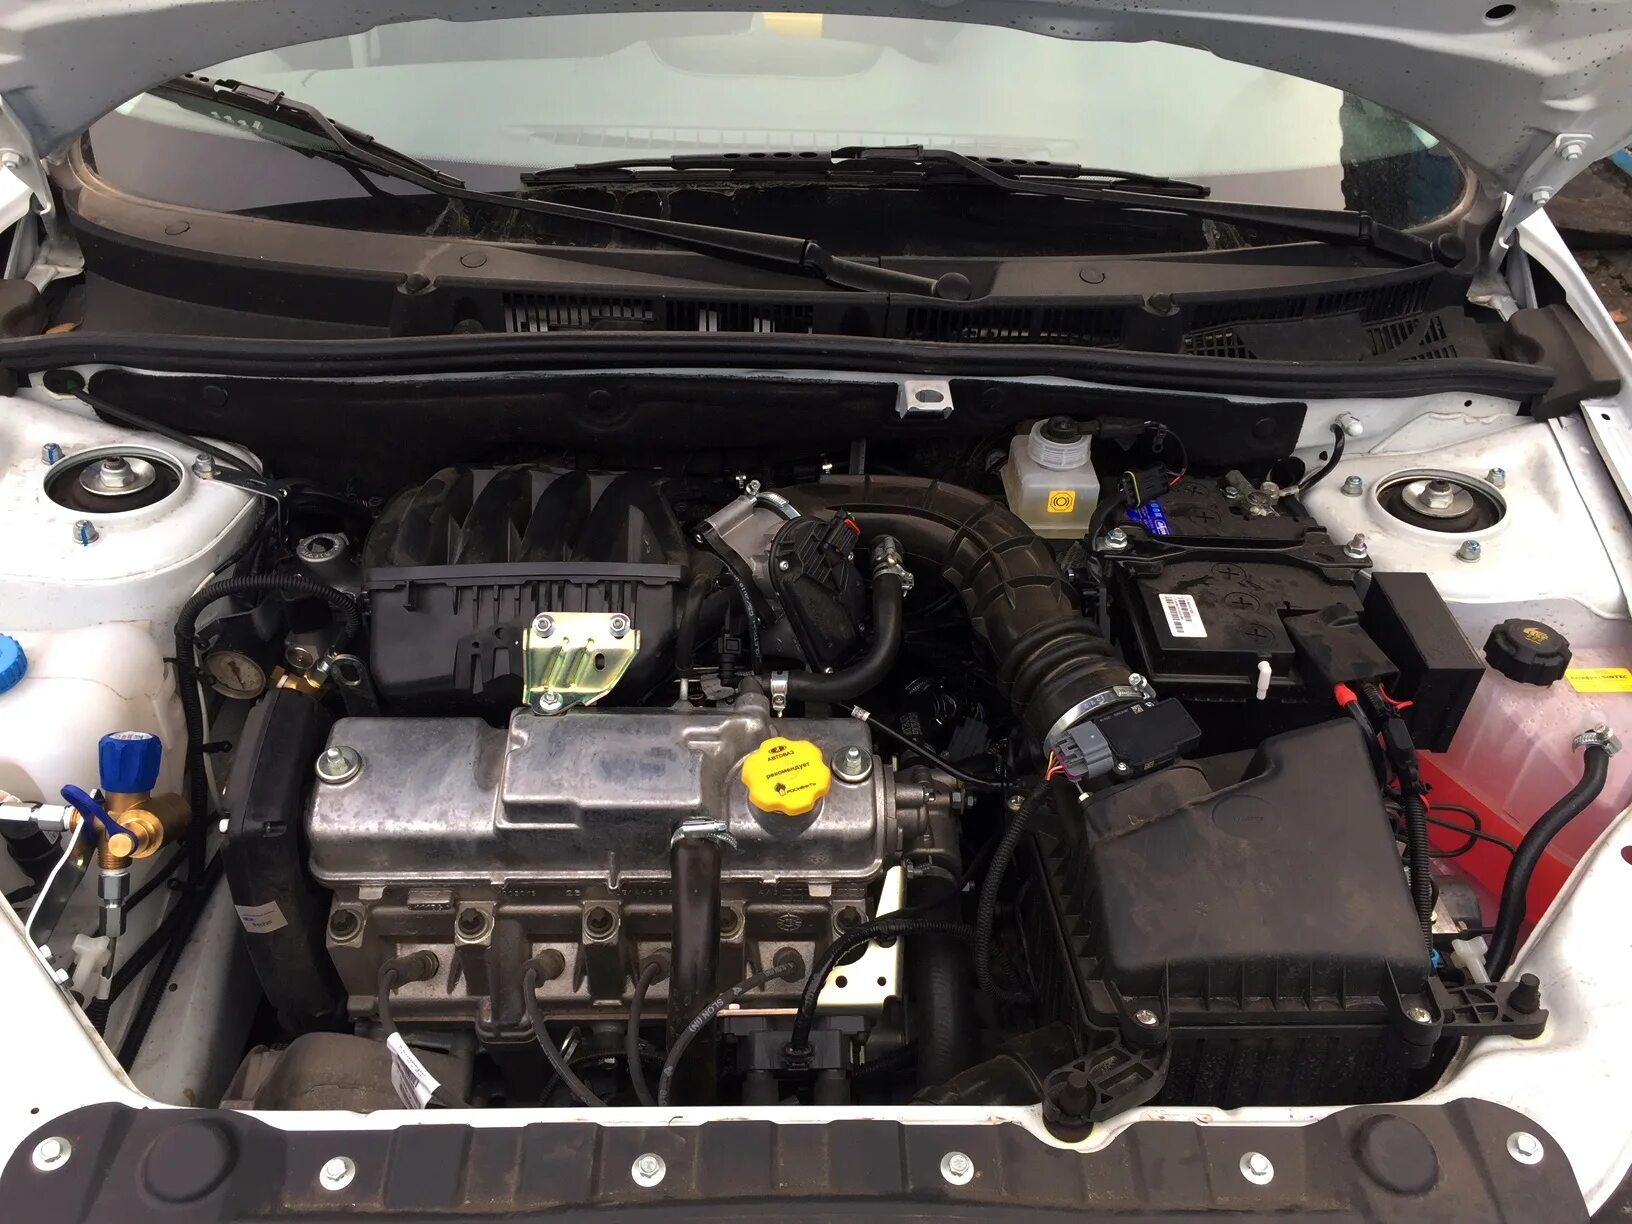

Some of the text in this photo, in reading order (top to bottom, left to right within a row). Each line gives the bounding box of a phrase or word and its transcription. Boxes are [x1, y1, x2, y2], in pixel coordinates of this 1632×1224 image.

[767, 750, 795, 761] АВТОВАЗ
[766, 762, 810, 779] рекомендует
[688, 998, 724, 1032] SLON (IN)
